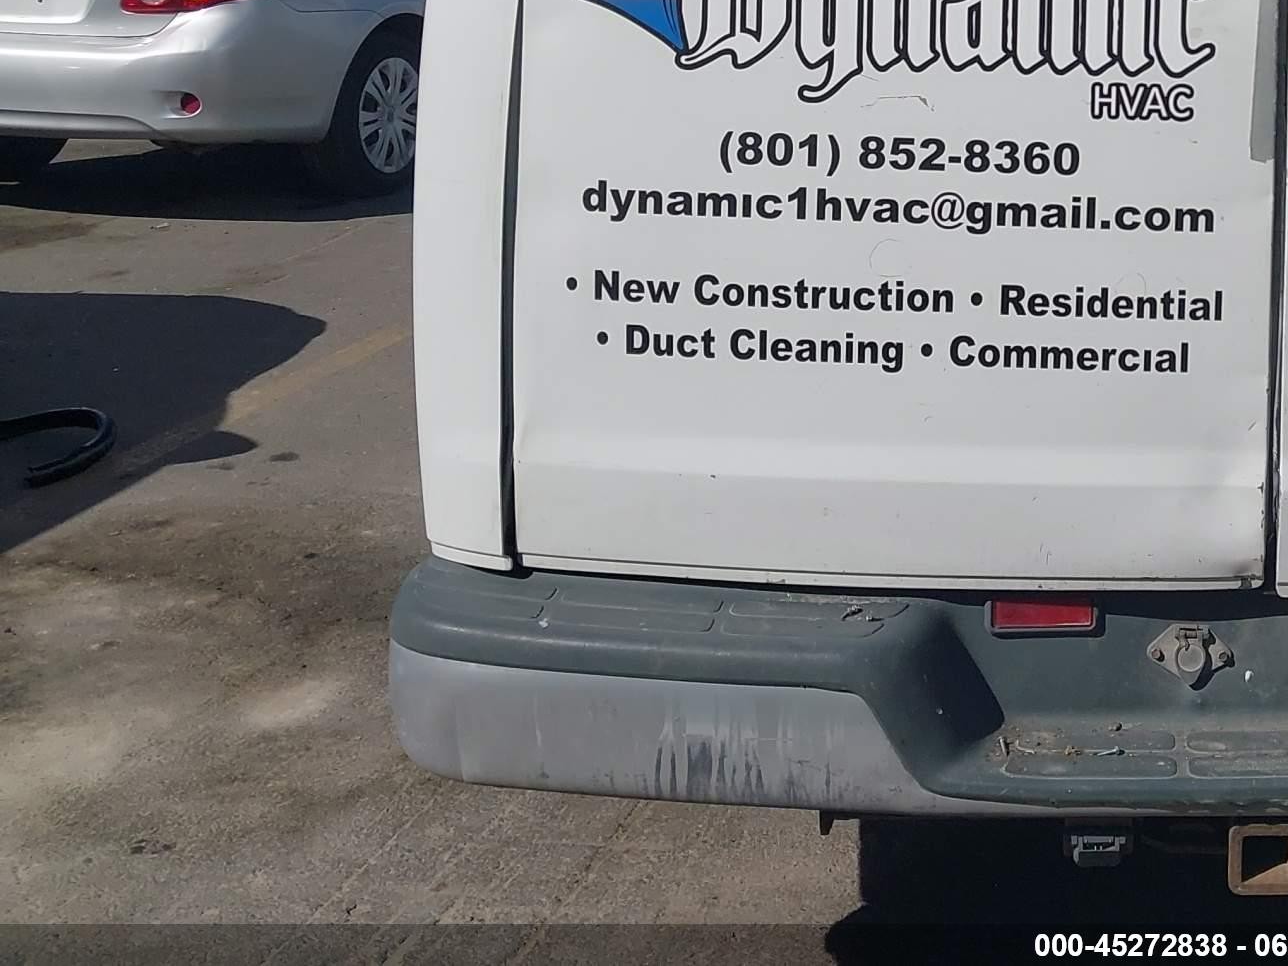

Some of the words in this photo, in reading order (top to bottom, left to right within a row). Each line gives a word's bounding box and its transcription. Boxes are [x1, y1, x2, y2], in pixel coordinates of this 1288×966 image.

[1091, 82, 1194, 122] HVAC
[721, 131, 841, 176] (801)
[859, 136, 1080, 175] 852-8360
[583, 180, 1214, 234] dynamic1hvac@gmail.com
[595, 270, 681, 304] New
[695, 275, 954, 313] Construction
[1001, 285, 1223, 321] Residential
[626, 325, 716, 359] Duct
[731, 329, 904, 374] Cleaning
[950, 336, 1189, 373] Commercial
